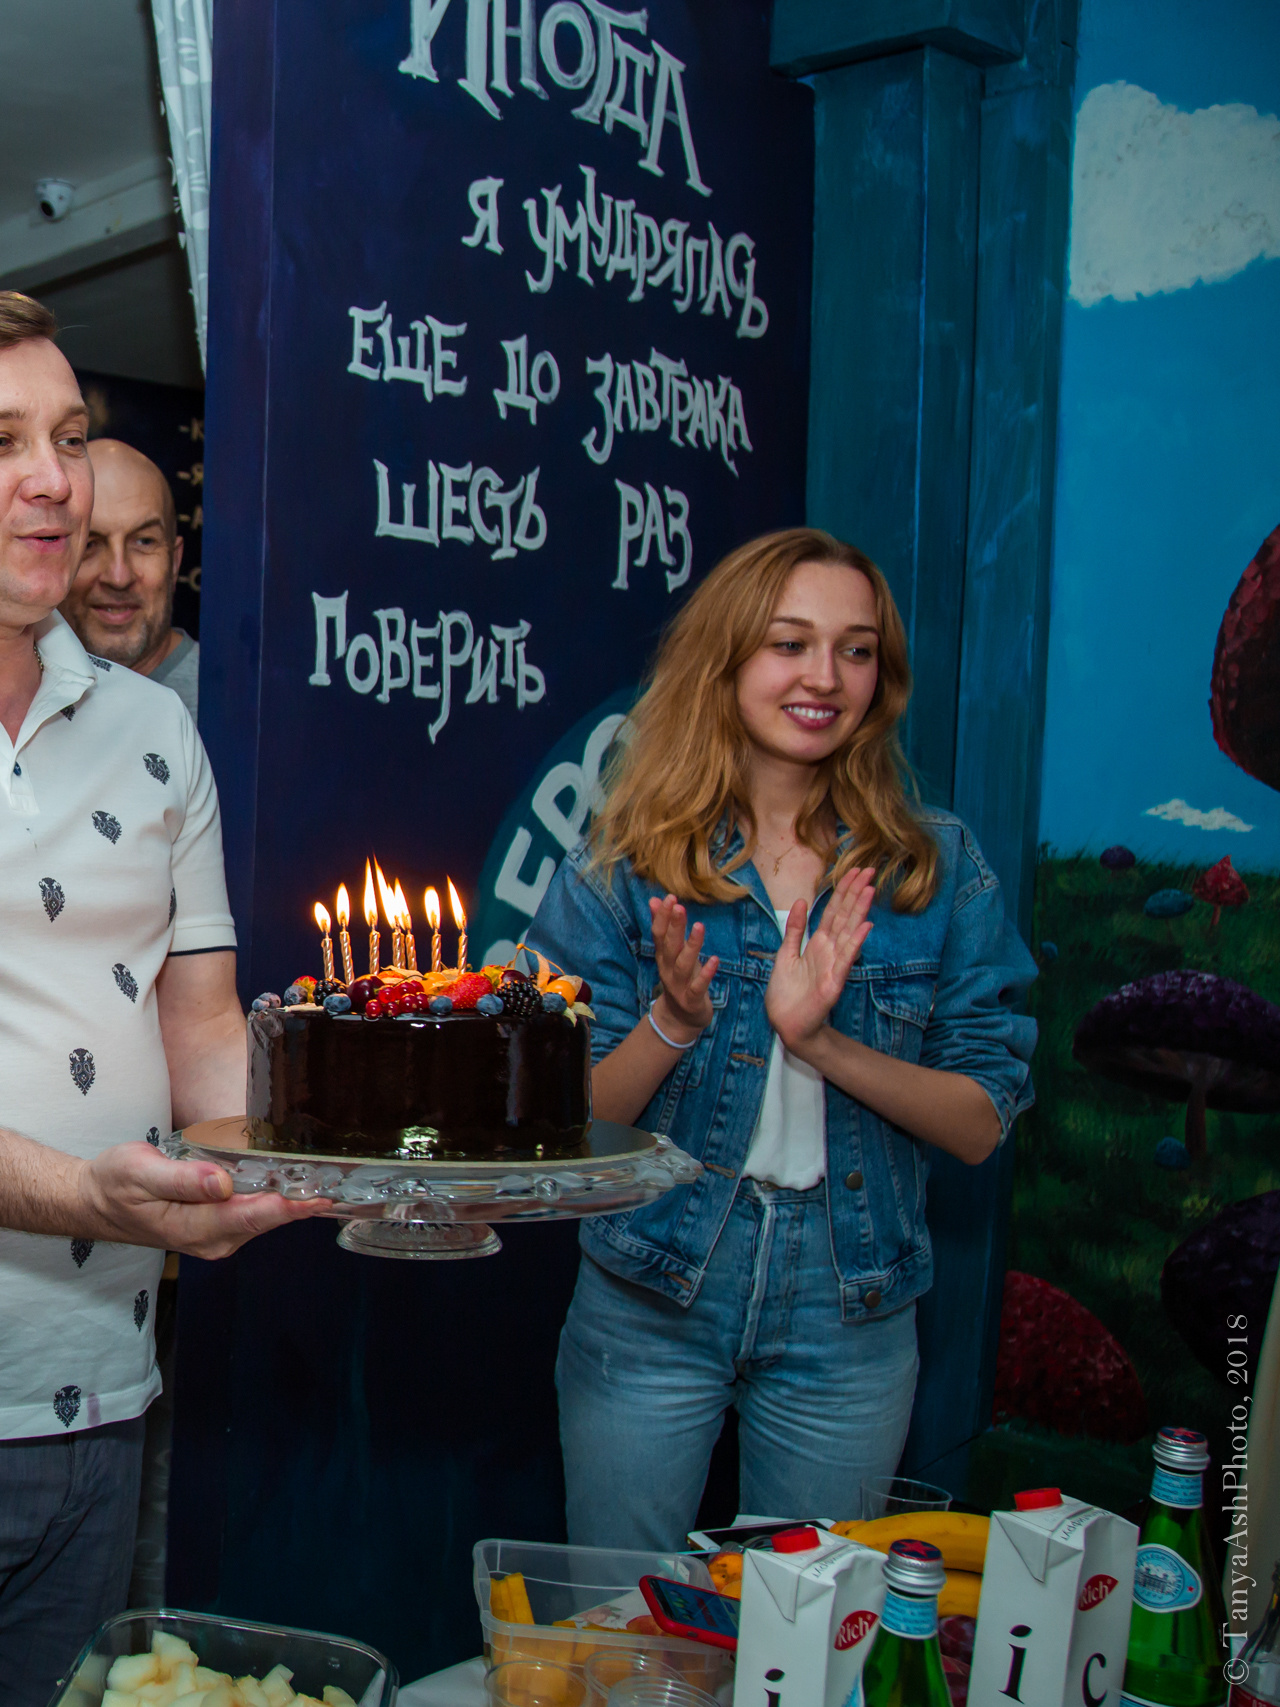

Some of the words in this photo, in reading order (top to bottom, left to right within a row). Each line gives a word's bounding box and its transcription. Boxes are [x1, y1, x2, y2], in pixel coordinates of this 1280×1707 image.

[461, 176, 504, 255] Я
[522, 163, 769, 338] УМУДРЯЛАСЬ
[347, 300, 468, 402] ЕЩЕ
[493, 334, 561, 425] ДО
[582, 347, 752, 477] ЗАВТРАКА
[373, 458, 548, 561] ШЕСТЬ
[611, 478, 693, 593] РАЗ
[308, 589, 546, 745] ПОВЕРИТЬ
[837, 1616, 870, 1648] Rich
